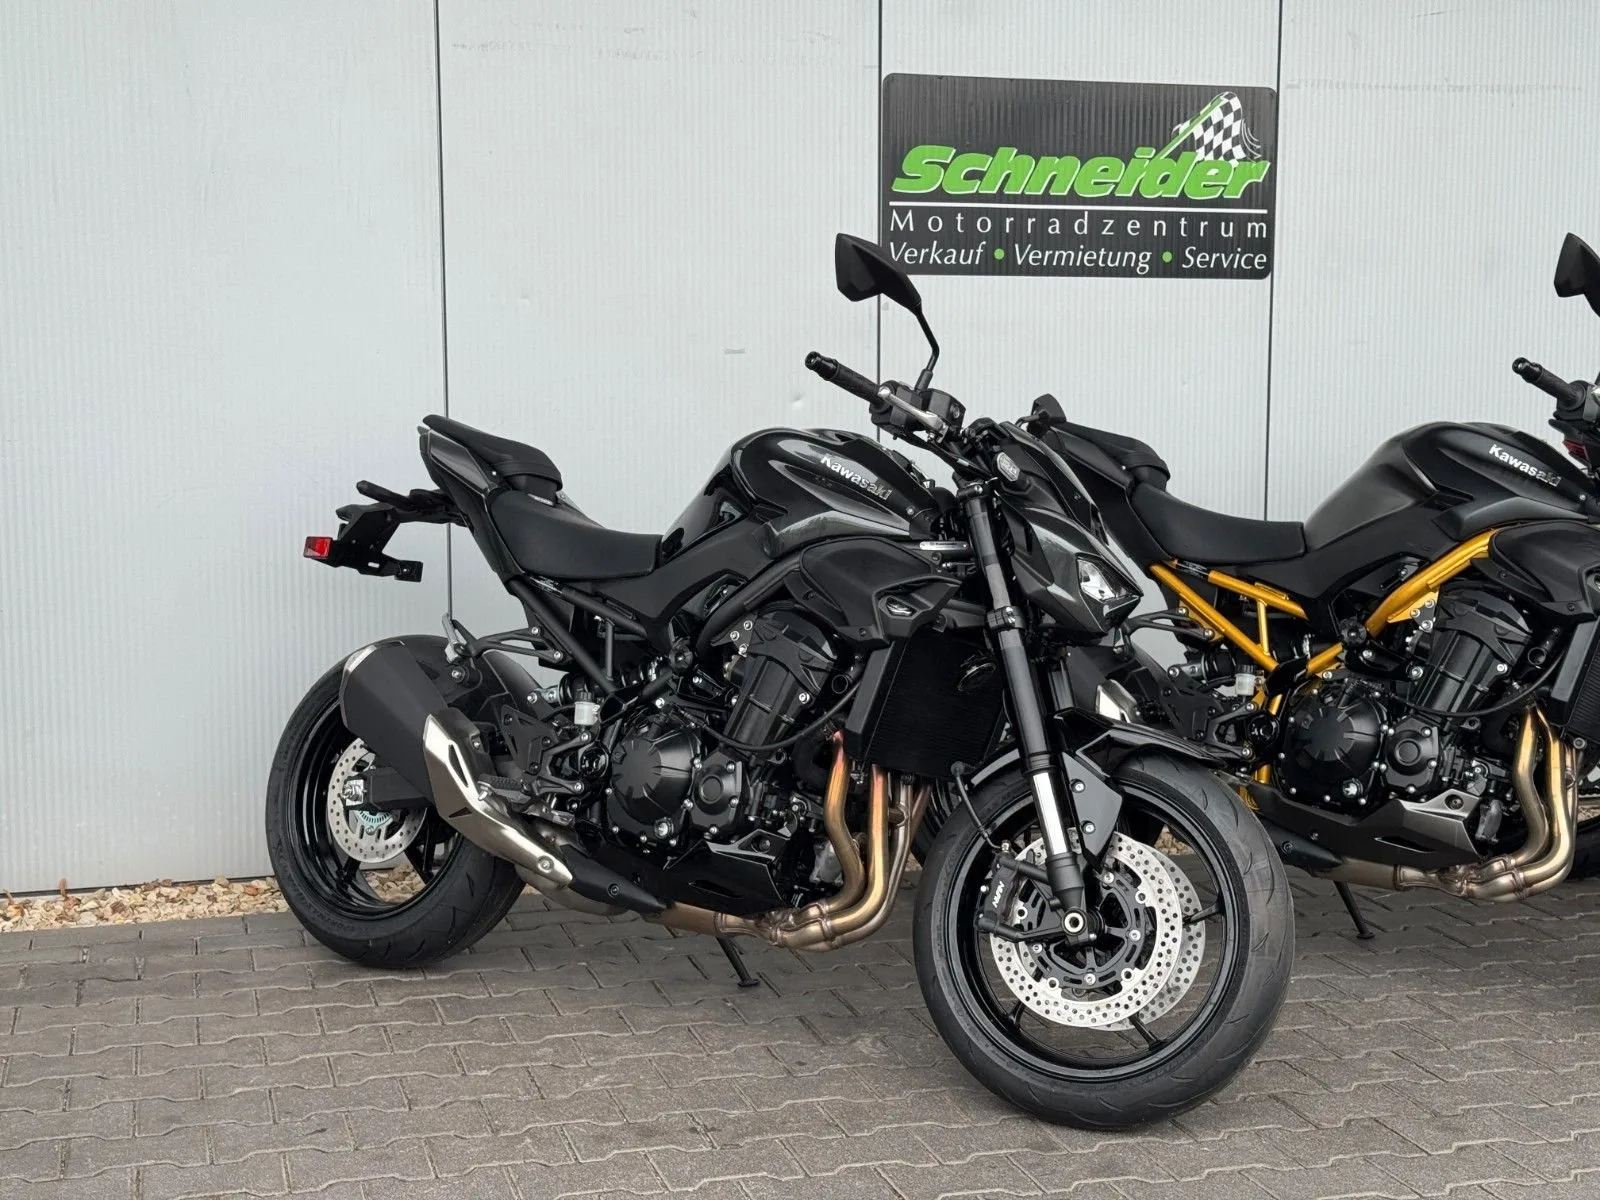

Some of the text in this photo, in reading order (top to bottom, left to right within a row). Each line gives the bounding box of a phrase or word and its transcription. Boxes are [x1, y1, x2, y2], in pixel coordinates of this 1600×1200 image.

[891, 144, 1271, 200] Schneider
[889, 208, 1268, 238] Motorradzentrum
[889, 240, 1268, 273] Verkauf Vermietung Service
[820, 453, 893, 501] Kawasaki
[1489, 444, 1562, 487] Kawasaki
